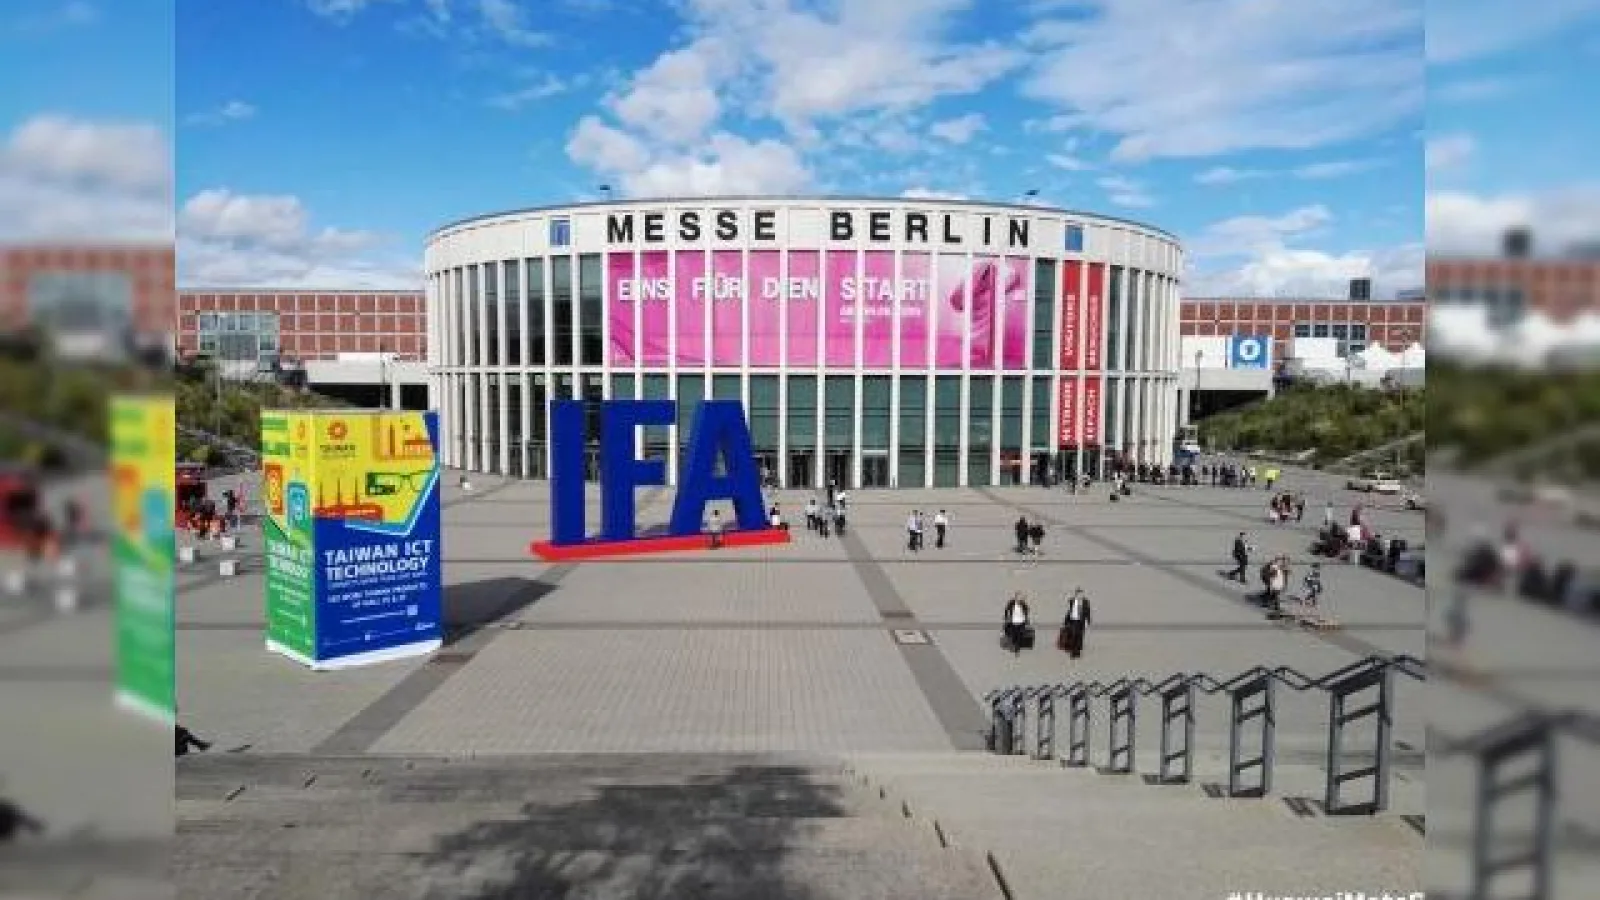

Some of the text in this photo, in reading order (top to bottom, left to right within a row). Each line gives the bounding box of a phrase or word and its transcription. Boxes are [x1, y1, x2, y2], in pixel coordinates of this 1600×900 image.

[607, 211, 1030, 247] MESSE BERLIN
[692, 271, 742, 299] FÜR
[763, 277, 820, 299] DEN
[840, 277, 928, 301] START
[550, 400, 765, 544] IFA
[324, 544, 398, 566] TAIWAN
[404, 540, 432, 556] ICT
[325, 557, 429, 581] TECHNOLOGY
